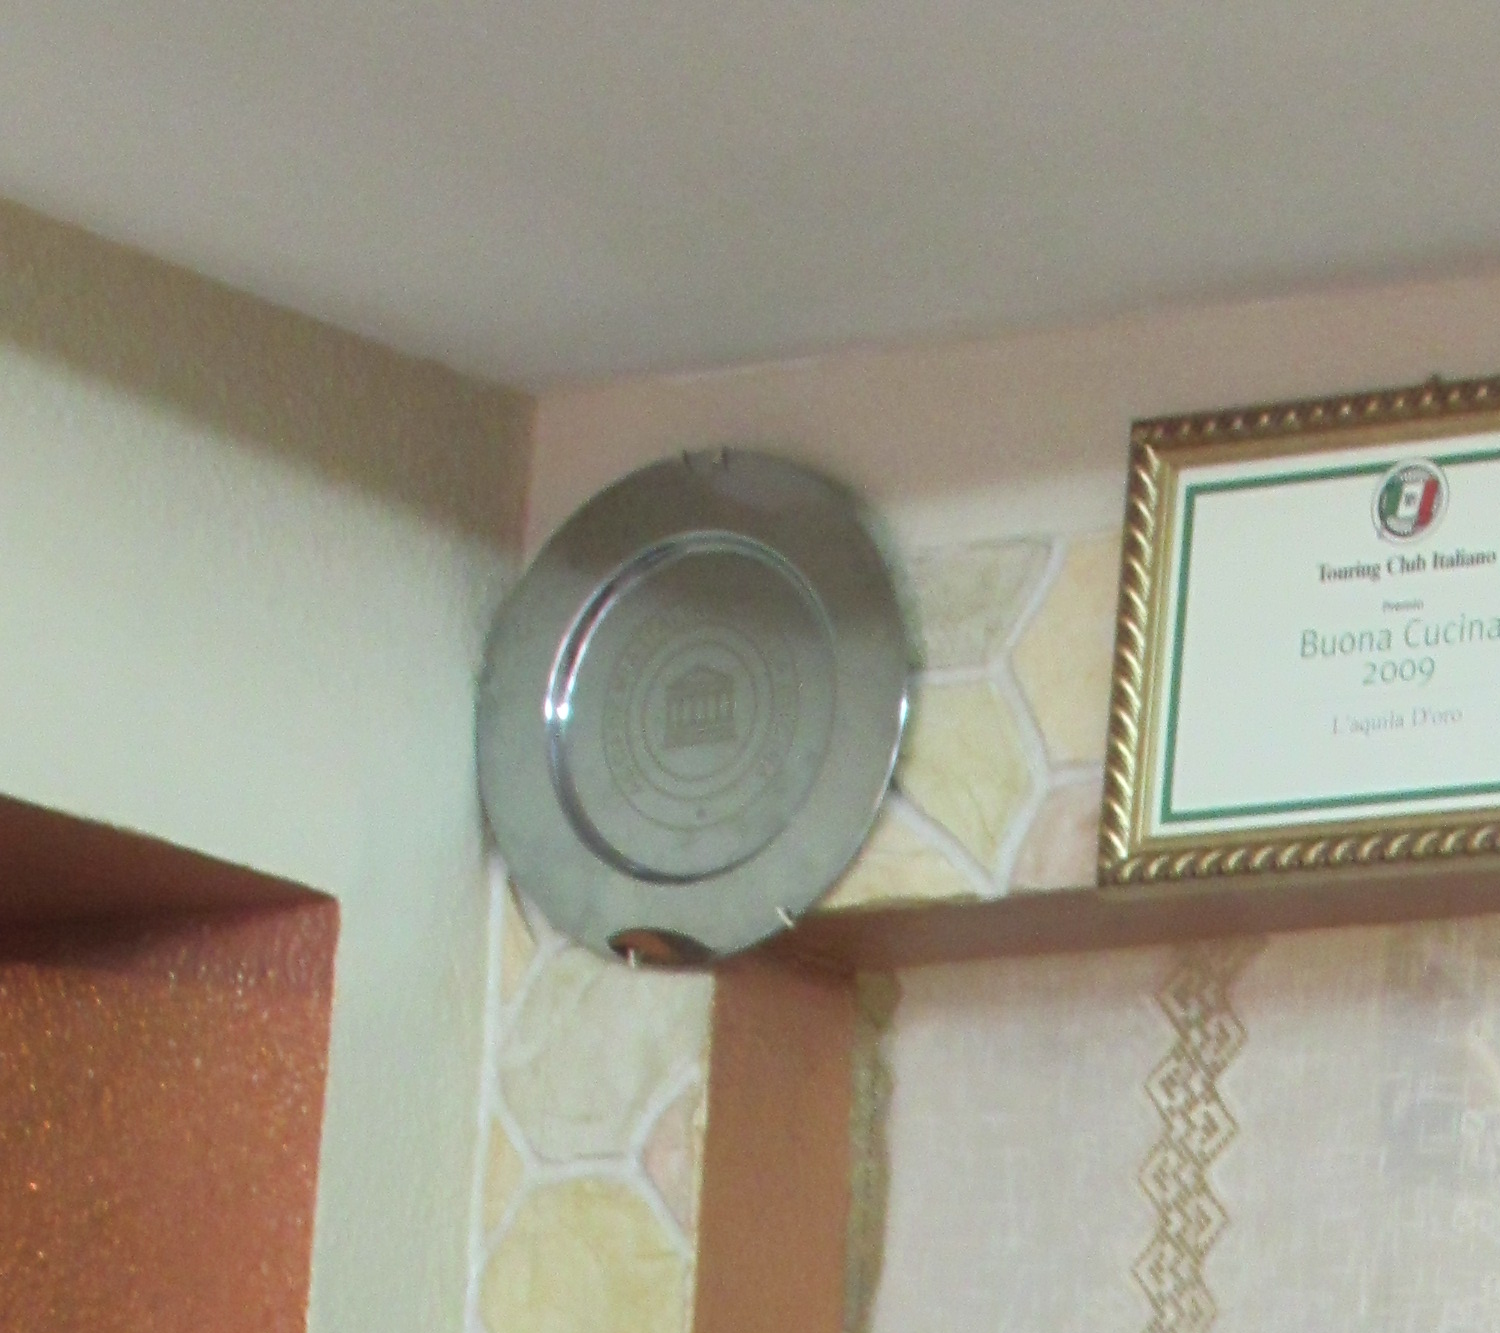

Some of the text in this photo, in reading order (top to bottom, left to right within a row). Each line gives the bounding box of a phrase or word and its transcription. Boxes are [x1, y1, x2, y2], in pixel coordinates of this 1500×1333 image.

[1319, 549, 1497, 582] Touring Club Italiano
[1300, 627, 1392, 658] Buona
[1362, 656, 1436, 687] 2009
